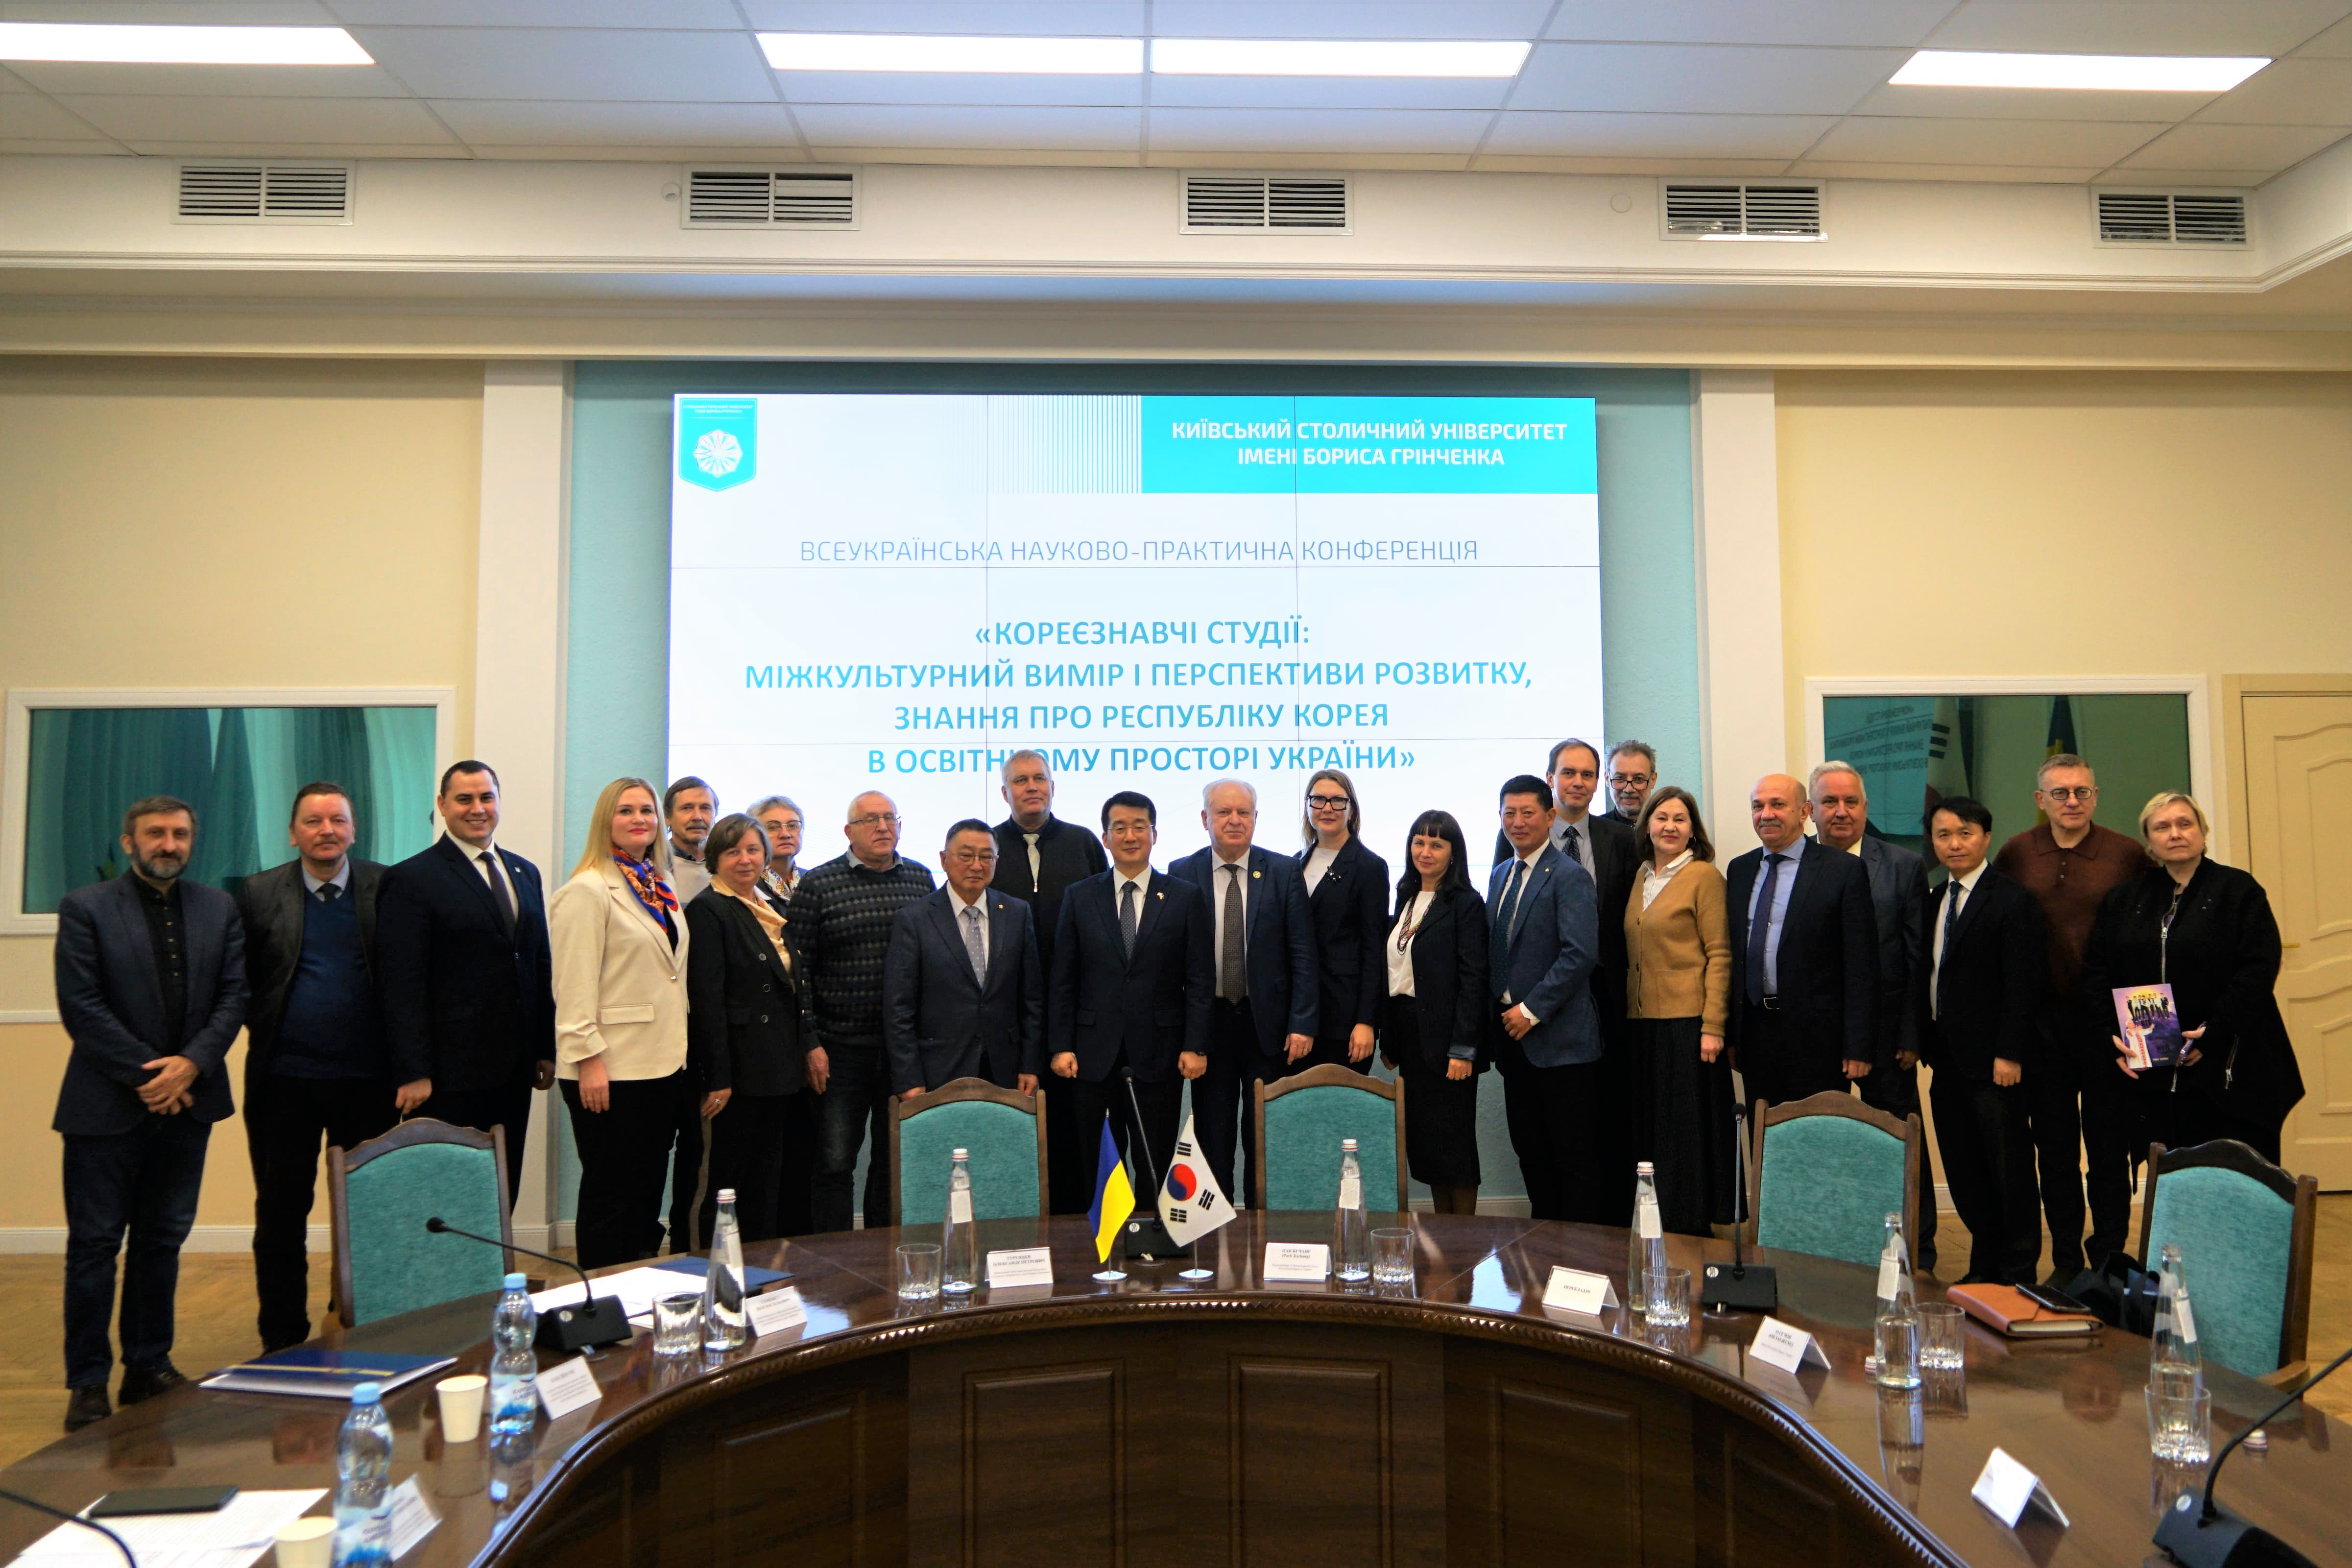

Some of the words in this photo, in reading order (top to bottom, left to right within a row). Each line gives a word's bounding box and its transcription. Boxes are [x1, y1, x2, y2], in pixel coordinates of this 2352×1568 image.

[1172, 418, 1291, 439] КИЇВСЬКИЙ
[1297, 419, 1425, 439] СТОЛИЧНИЙ
[1430, 423, 1568, 440] УНІВЕРСИТЕТ
[1238, 448, 1297, 465] ІМЕНІ
[1303, 448, 1386, 465] БОРИСА
[1391, 448, 1505, 465] ГРІНЧЕНКА
[801, 537, 1003, 561] ВСЕУКРАЇНСЬКА
[1011, 541, 1295, 561] НАУКОВО-ПРАКТИЧНА
[1302, 539, 1477, 564] КОНФЕРЕНЦІЯ
[976, 621, 1196, 646] «КОРЕЄЗНАВЧІ
[1207, 615, 1309, 649] СТУДІЇ:
[746, 658, 1013, 688] МІЖКУЛЬТУРНИЙ
[1026, 664, 1124, 687] ВИМІР
[1134, 664, 1140, 686] І
[1152, 662, 1364, 686] ПЕРСПЕКТИВИ
[1375, 662, 1532, 688] РОЗВИТКУ,
[895, 706, 1018, 730] ЗНАННЯ
[1030, 705, 1091, 729] ПРО
[1103, 704, 1284, 728] РЕСПУБЛІКУ
[1295, 703, 1388, 727] КОРЕЯ
[868, 750, 885, 773] В
[896, 748, 1101, 773] ОСВІТНМУ
[1111, 747, 1257, 771] ПРОСТОРІ
[1267, 740, 1415, 770] УКРАЇНИ»
